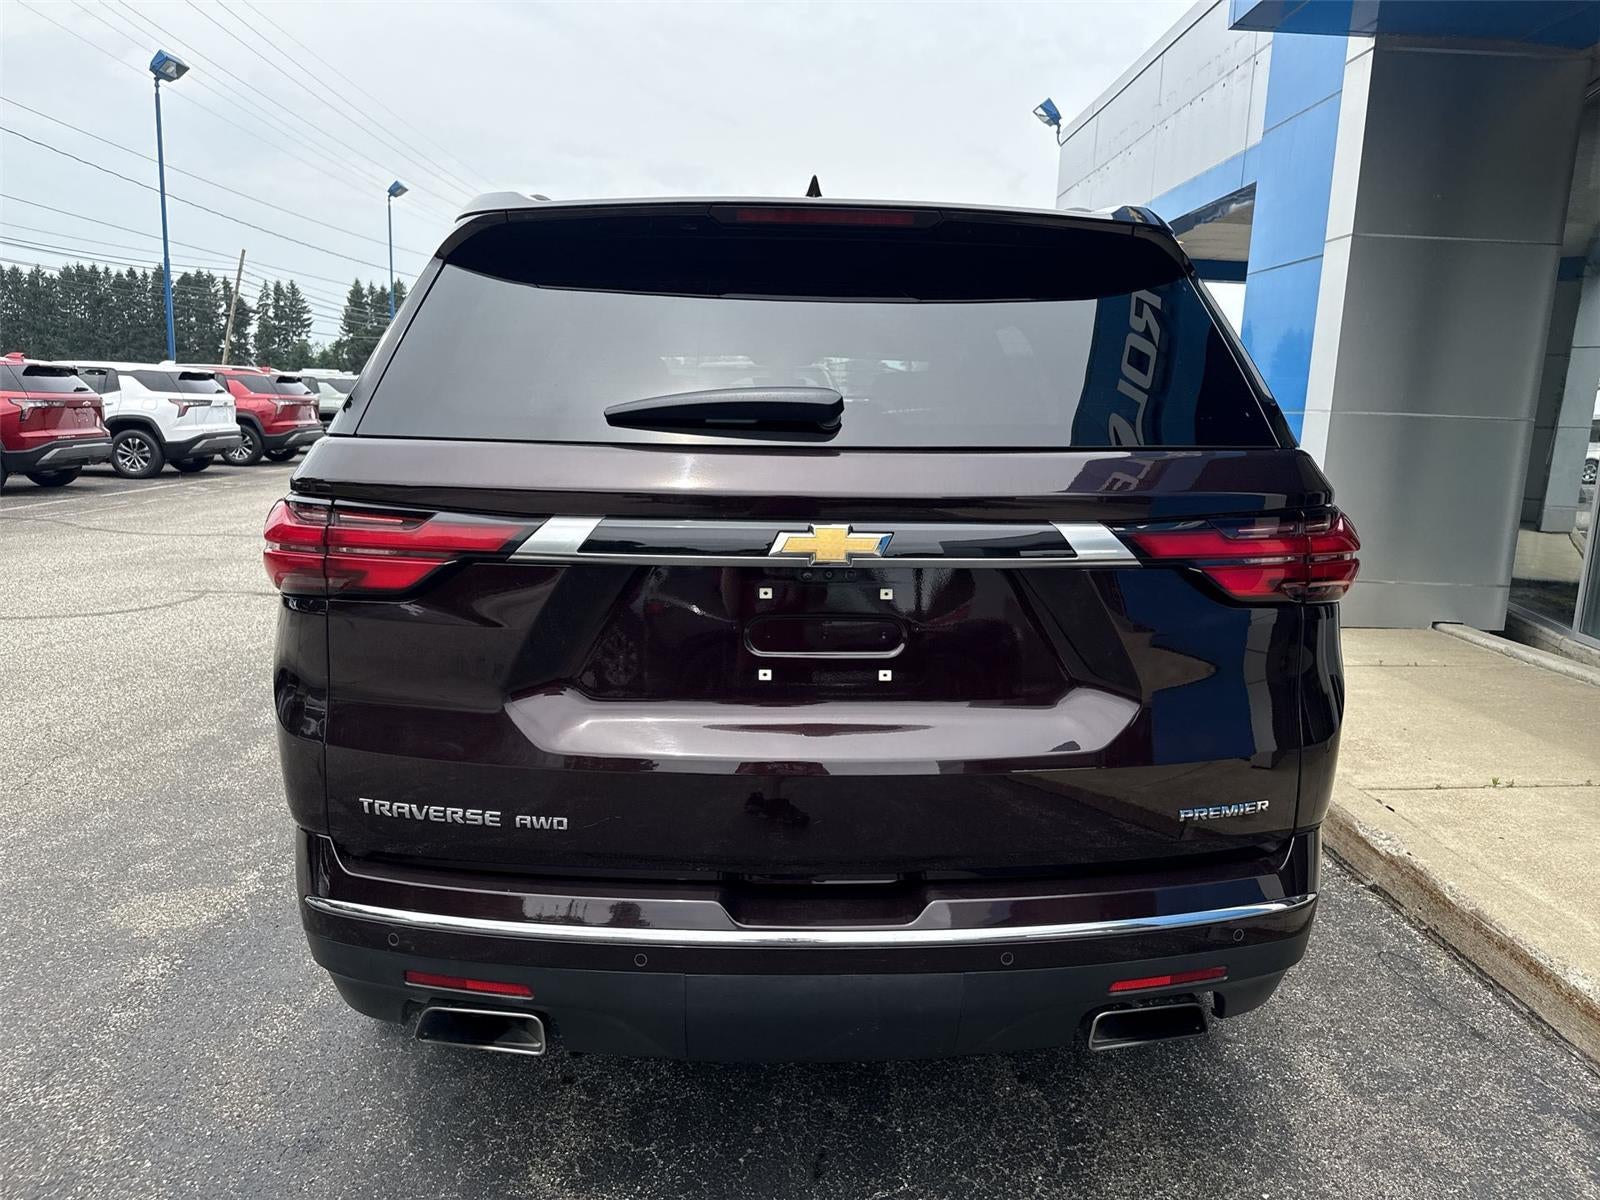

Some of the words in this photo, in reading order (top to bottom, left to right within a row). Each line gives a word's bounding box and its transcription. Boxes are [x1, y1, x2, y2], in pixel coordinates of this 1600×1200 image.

[359, 798, 501, 827] TRAVERSE
[515, 815, 568, 830] AWD
[1179, 800, 1270, 822] PREMIER
